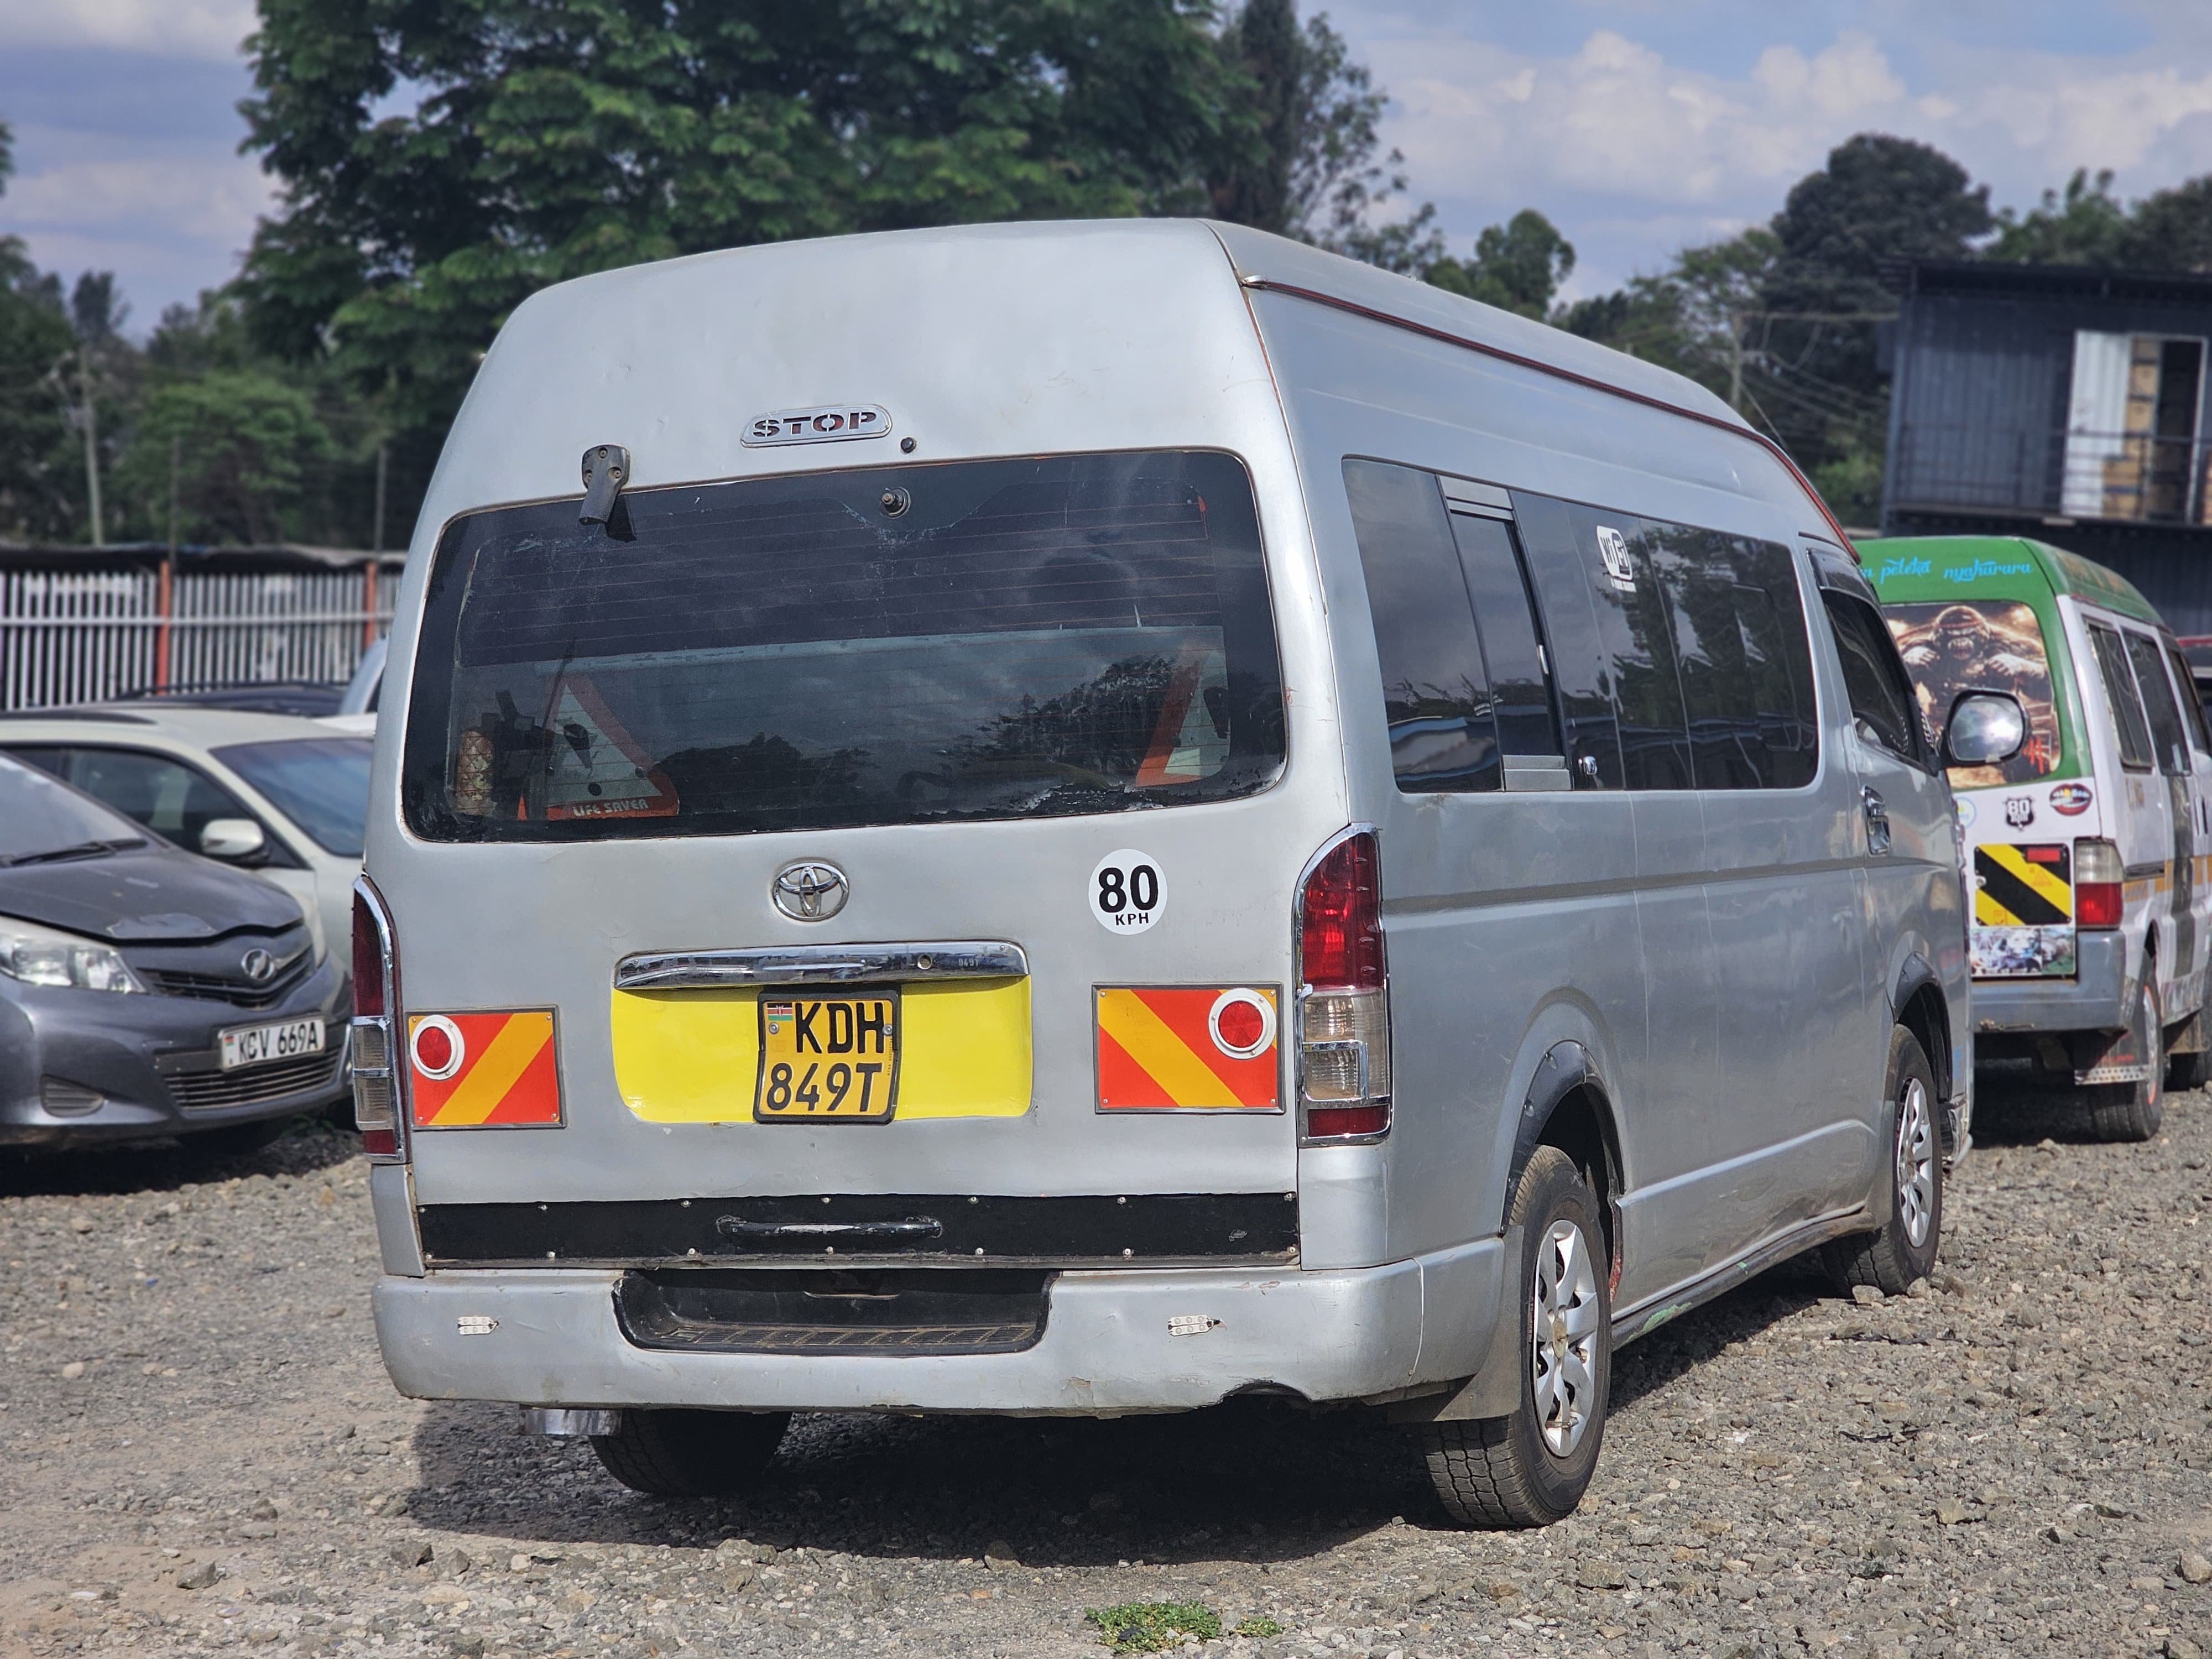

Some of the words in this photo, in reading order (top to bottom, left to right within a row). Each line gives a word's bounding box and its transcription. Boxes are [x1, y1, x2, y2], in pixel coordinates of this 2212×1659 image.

[752, 411, 877, 438] STOP
[603, 799, 649, 813] SAVER
[2008, 800, 2030, 814] 80
[1098, 864, 1159, 913] 80
[1115, 912, 1150, 926] KPH
[238, 1029, 270, 1063] KCV
[278, 1021, 319, 1055] 669A
[795, 1001, 884, 1054] KDH
[766, 1062, 883, 1112] 849T
